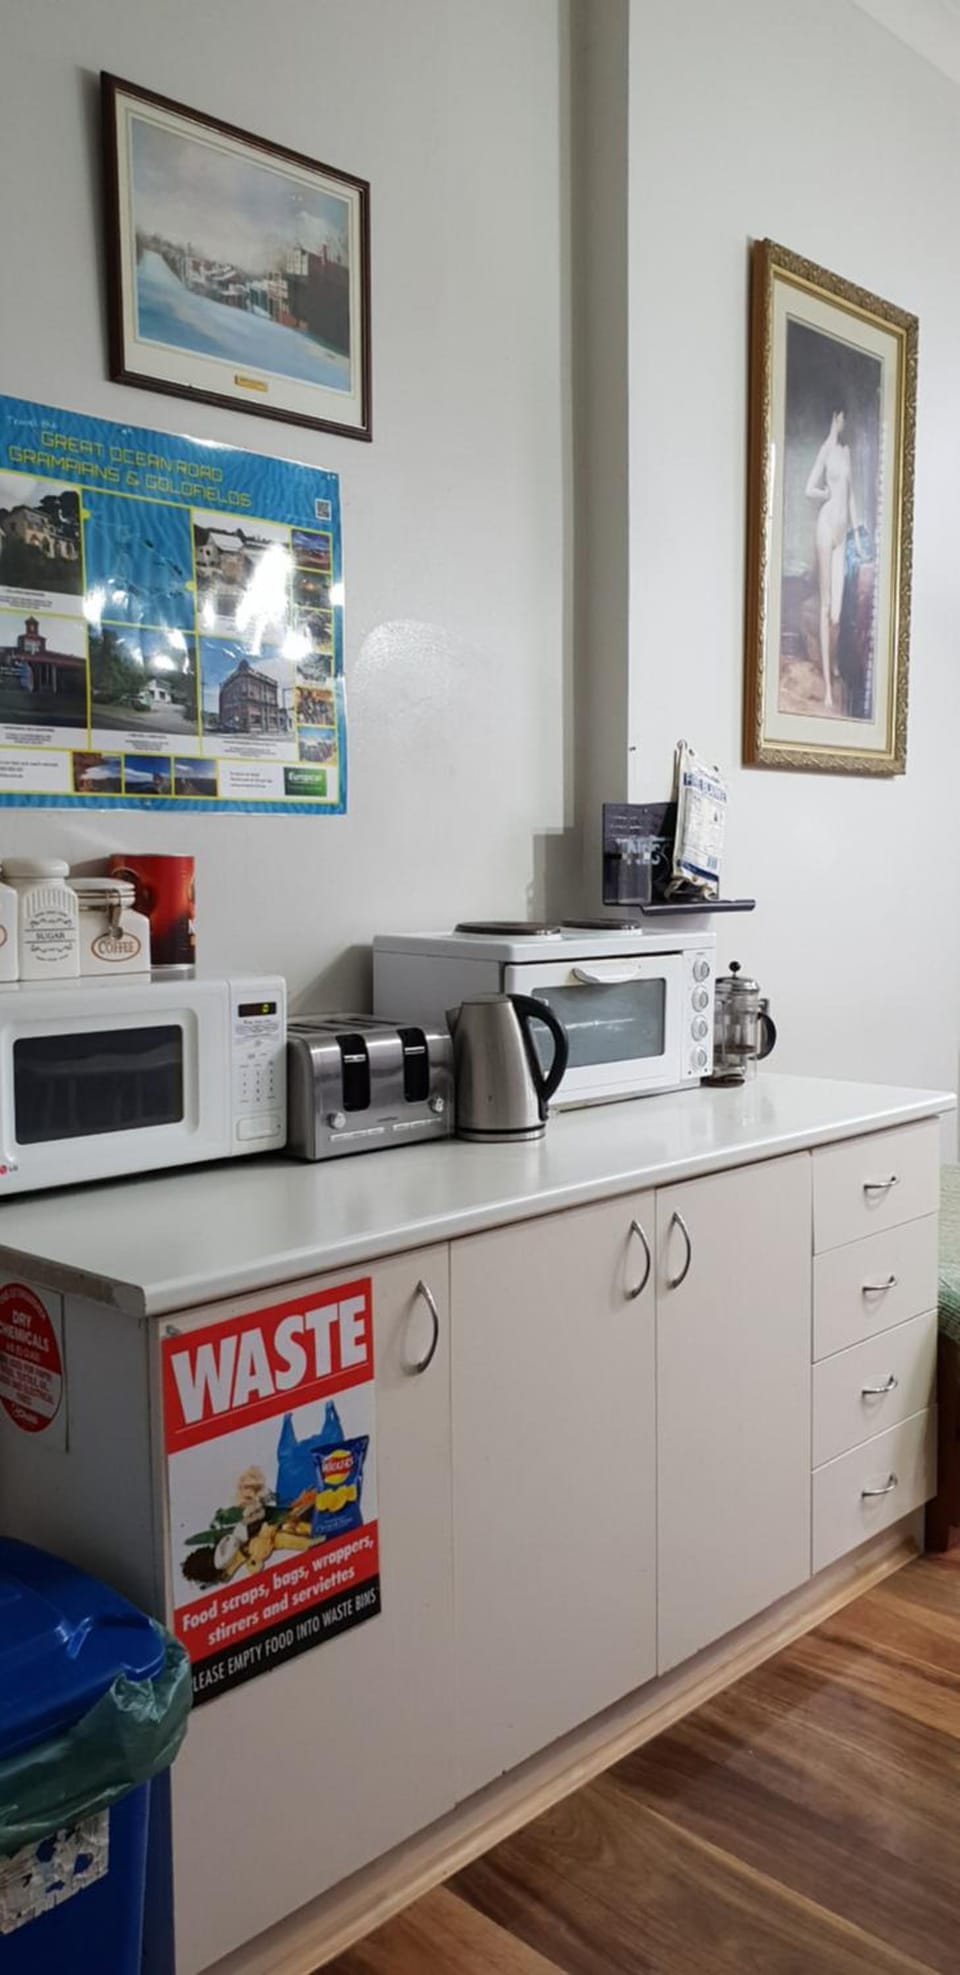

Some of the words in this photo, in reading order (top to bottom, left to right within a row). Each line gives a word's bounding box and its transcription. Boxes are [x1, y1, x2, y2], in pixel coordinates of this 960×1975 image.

[8, 444, 120, 483] GRAMPIANS
[145, 473, 252, 508] GOLDFIELDS
[41, 431, 104, 457] GREAT
[109, 446, 173, 473] OCEAN
[176, 459, 224, 483] ROAD
[36, 932, 66, 941] SUGAR
[97, 939, 136, 955] COFFEE
[12, 1309, 32, 1328] DRY
[170, 1295, 368, 1425] WASTE
[182, 1599, 219, 1632] Food
[221, 1584, 271, 1614] scraps,
[272, 1568, 309, 1591] bags,
[312, 1535, 374, 1573] wrappers,
[208, 1613, 260, 1646] stirrers
[263, 1593, 289, 1618] and
[292, 1566, 355, 1606] serviettes
[191, 1662, 225, 1692] LEASE
[228, 1644, 262, 1676] EMPTY
[264, 1629, 294, 1657] FOOD
[296, 1616, 320, 1641] INTO
[322, 1598, 353, 1628] WASTE
[355, 1588, 377, 1611] BINS
